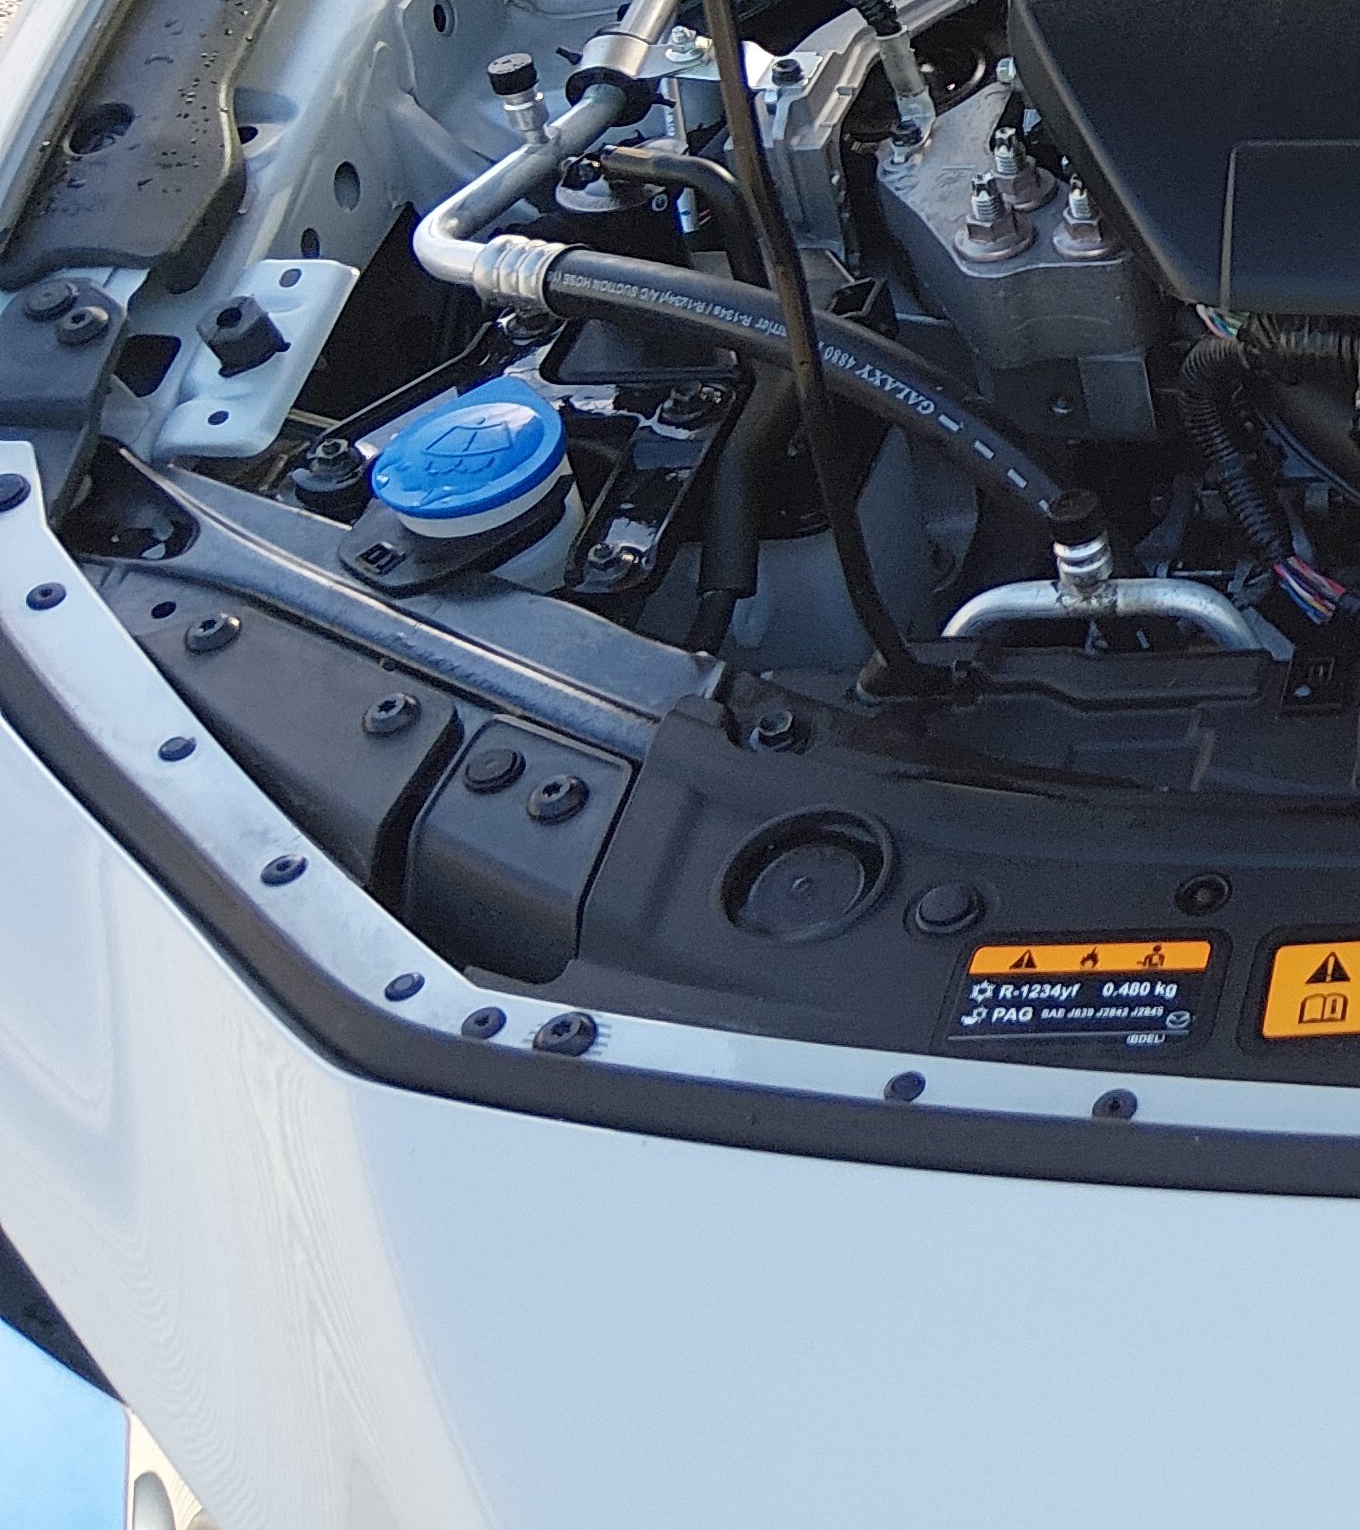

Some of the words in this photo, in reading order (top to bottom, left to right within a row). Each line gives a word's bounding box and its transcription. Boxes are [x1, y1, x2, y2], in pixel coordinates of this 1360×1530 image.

[592, 279, 639, 297] SUCTION
[714, 305, 753, 327] R-134a
[823, 346, 856, 369] 4880
[854, 364, 936, 415] GALAXY
[998, 982, 1082, 1000] R-1234yf
[1154, 980, 1178, 999] kg
[991, 1006, 1034, 1022] PAG
